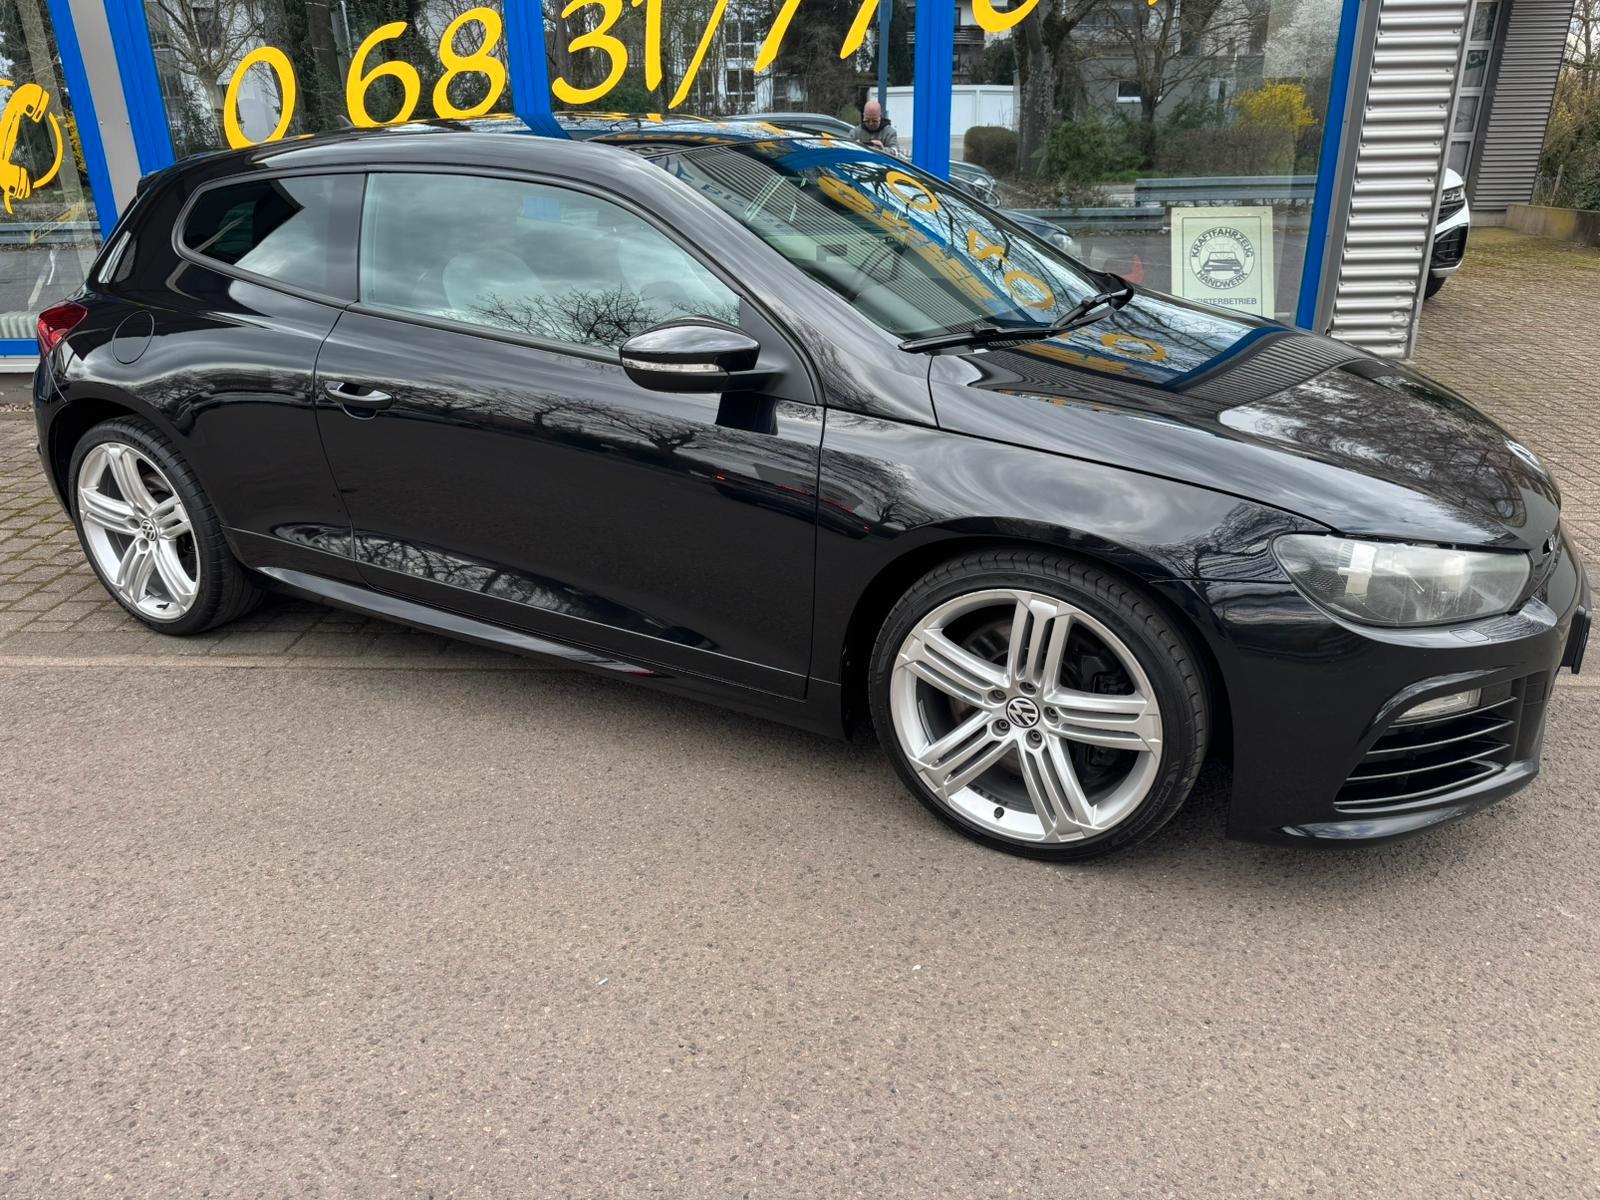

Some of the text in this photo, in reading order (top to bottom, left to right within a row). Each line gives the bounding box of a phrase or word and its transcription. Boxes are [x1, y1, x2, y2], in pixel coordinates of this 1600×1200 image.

[1191, 228, 1255, 258] KRAFTFAHRZEUG
[1196, 269, 1248, 288] HANDWERK
[1194, 297, 1257, 305] ISTERBETRIEB
